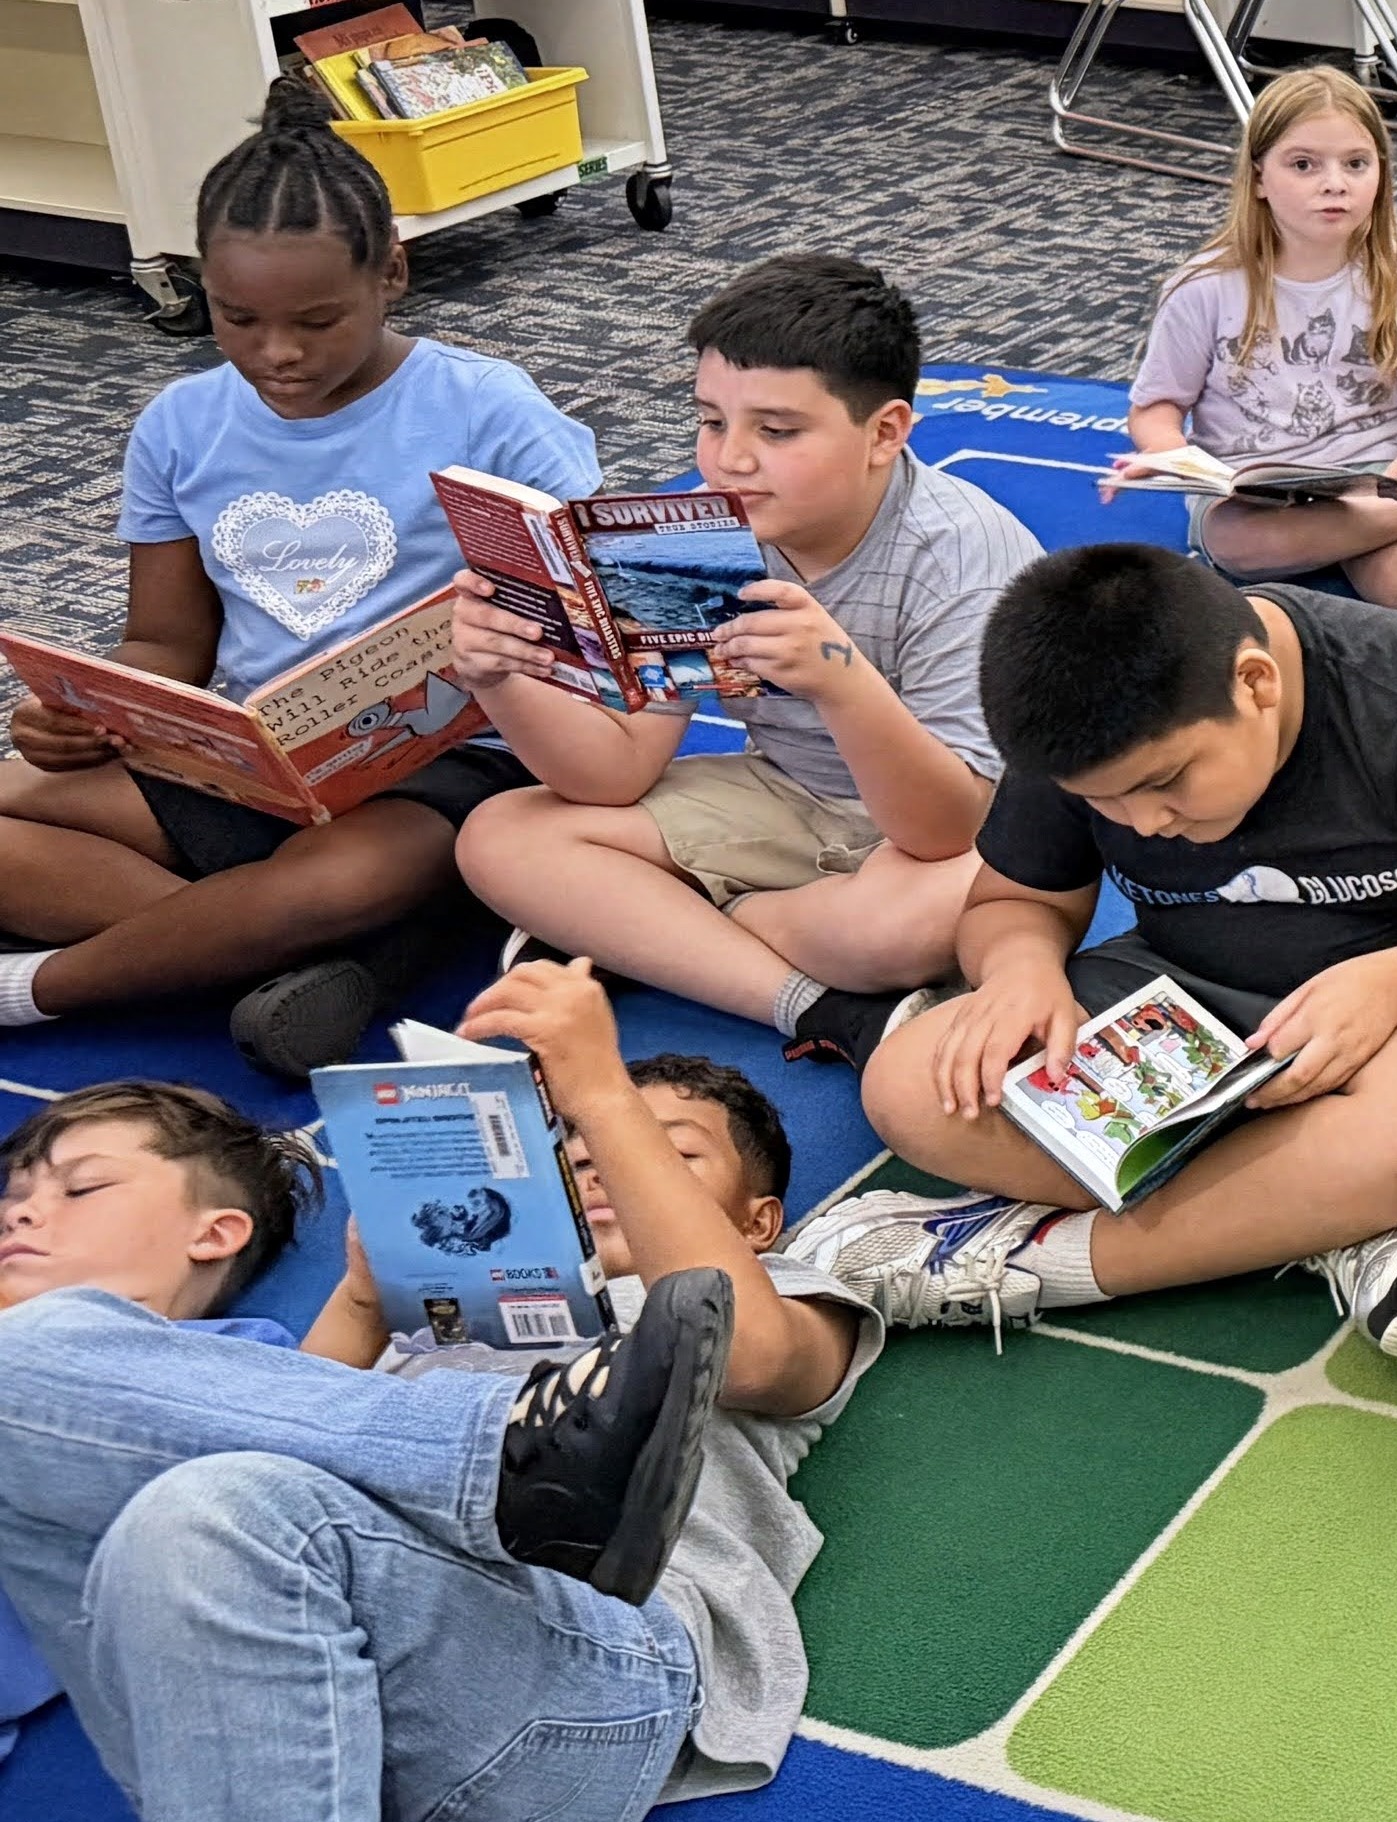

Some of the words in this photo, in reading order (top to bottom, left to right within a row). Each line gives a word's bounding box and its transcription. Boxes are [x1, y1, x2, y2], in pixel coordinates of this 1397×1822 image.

[573, 503, 591, 528] I
[591, 496, 730, 527] SURVIVED
[657, 522, 687, 534] TRUE
[690, 519, 738, 532] STORIES
[258, 540, 360, 584] Lovely
[639, 632, 668, 646] FIVE
[669, 631, 696, 645] EPIC
[259, 686, 304, 719] The
[319, 626, 410, 683] Pigeon
[266, 694, 326, 733] Will
[339, 651, 400, 691] Ride
[412, 618, 451, 647] the
[275, 693, 359, 748] Roller
[1112, 864, 1220, 906] KETONES
